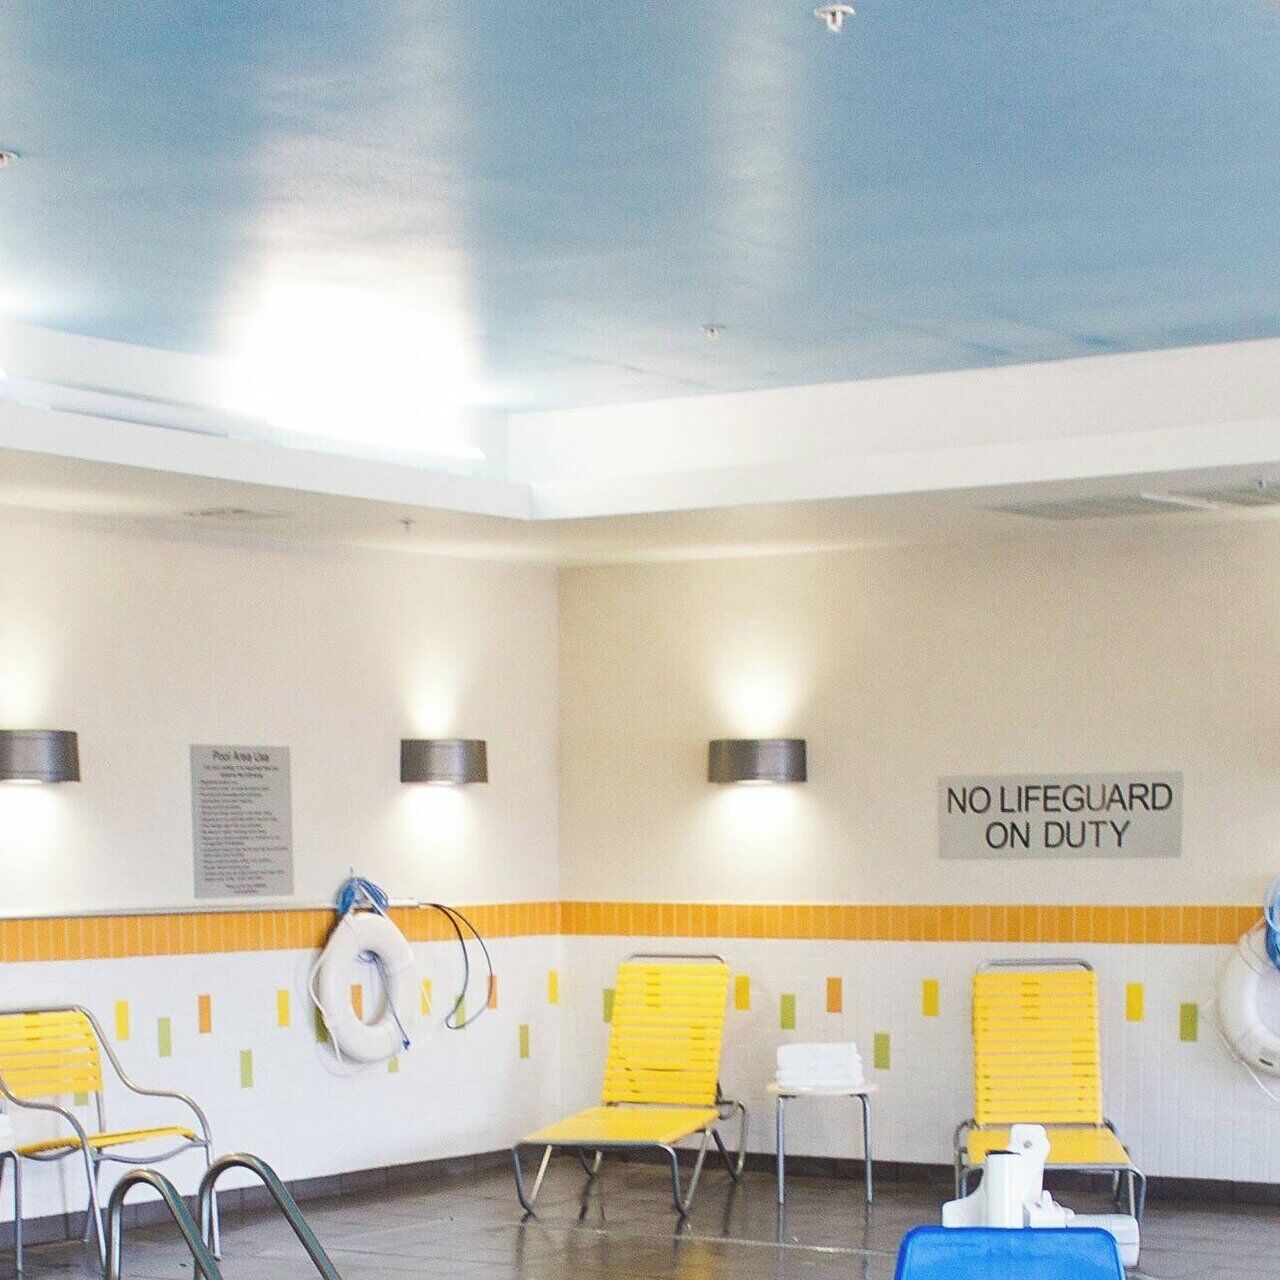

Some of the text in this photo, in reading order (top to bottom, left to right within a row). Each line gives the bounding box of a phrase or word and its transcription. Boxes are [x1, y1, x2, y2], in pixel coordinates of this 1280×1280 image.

[947, 782, 1174, 814] NO LIFEGUARD
[985, 820, 1131, 849] ON DUTY
